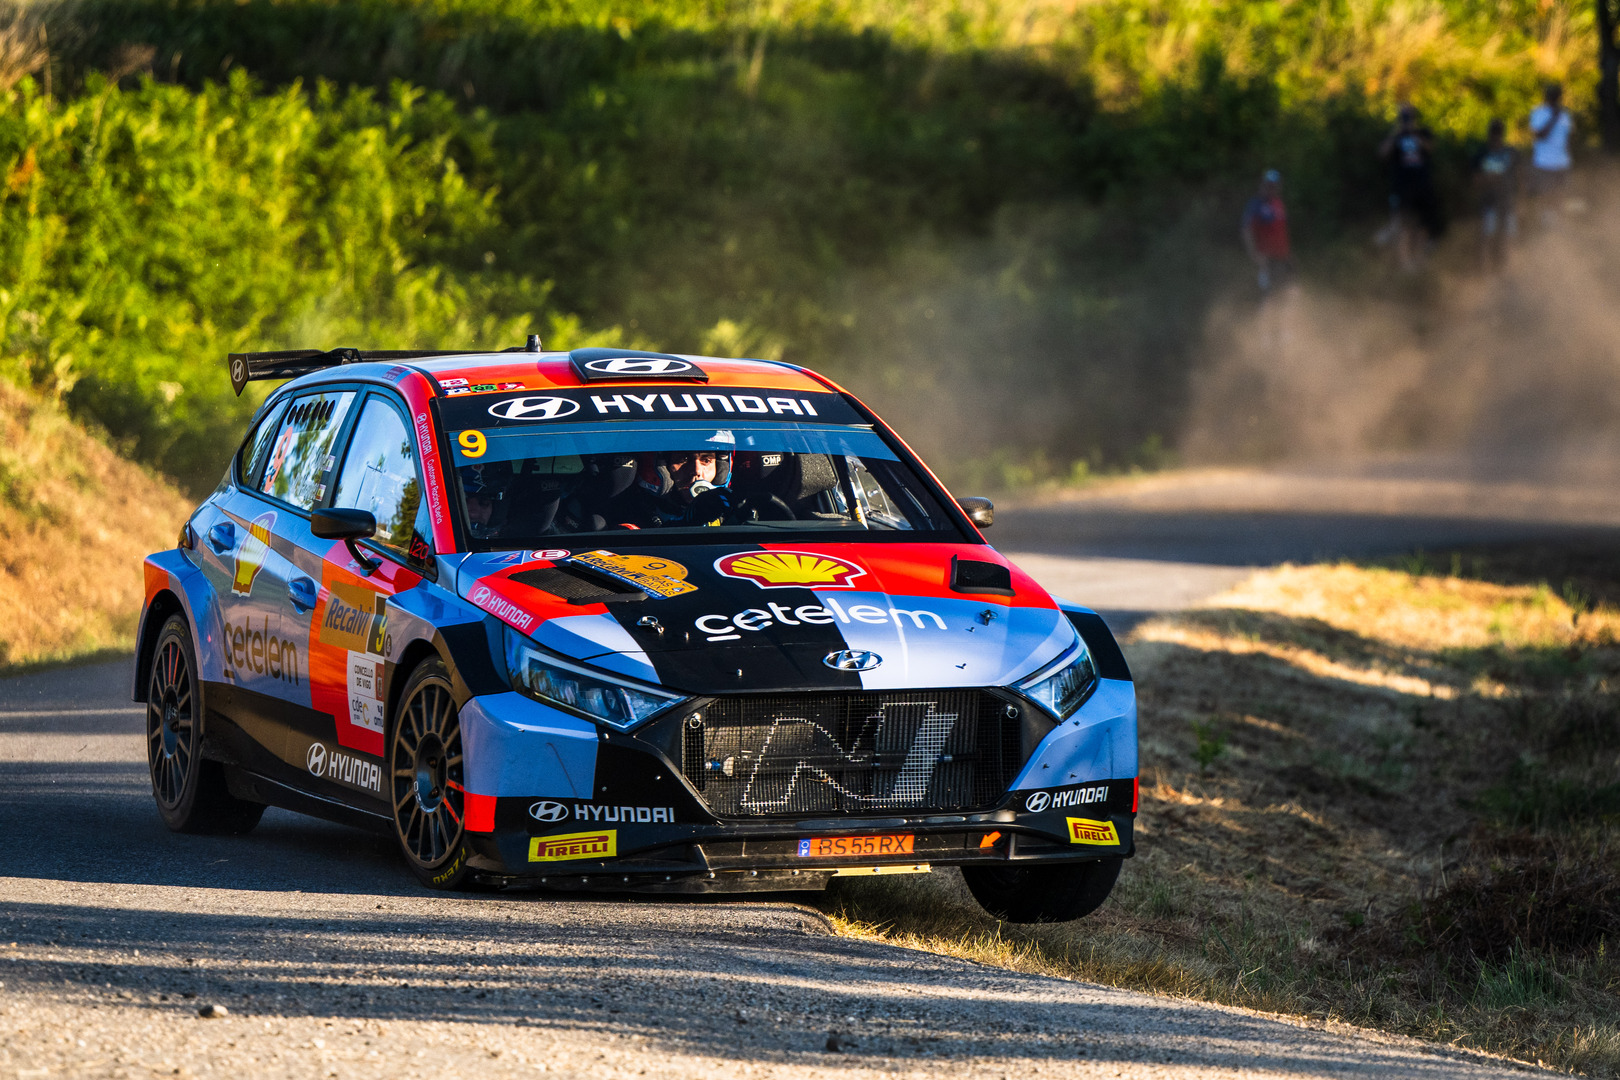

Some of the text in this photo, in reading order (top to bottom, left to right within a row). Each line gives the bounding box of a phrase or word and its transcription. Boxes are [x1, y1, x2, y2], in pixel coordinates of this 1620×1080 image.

[590, 394, 818, 416] HYUNDAI
[419, 422, 432, 455] HYUNDAI
[458, 429, 487, 458] 9
[264, 426, 293, 493] 9
[762, 456, 781, 466] OMP
[427, 459, 436, 486] Customer
[432, 485, 440, 508] Racing
[409, 537, 429, 560] i20
[643, 562, 667, 570] 9
[325, 598, 372, 636] Recalvi
[487, 595, 534, 630] HYUNDAI
[695, 598, 948, 642] cetelem
[223, 615, 299, 686] cetelem
[354, 665, 373, 678] CONCELLO
[356, 676, 371, 689] DE VIGO
[328, 751, 382, 793] HYUNDAI
[1052, 786, 1109, 808] HYUNDAI
[574, 804, 676, 823] HYUNDAI
[1072, 822, 1114, 841] PIRELLI
[537, 835, 609, 857] PIRELLI
[851, 837, 875, 854] 55
[879, 835, 907, 853] RX
